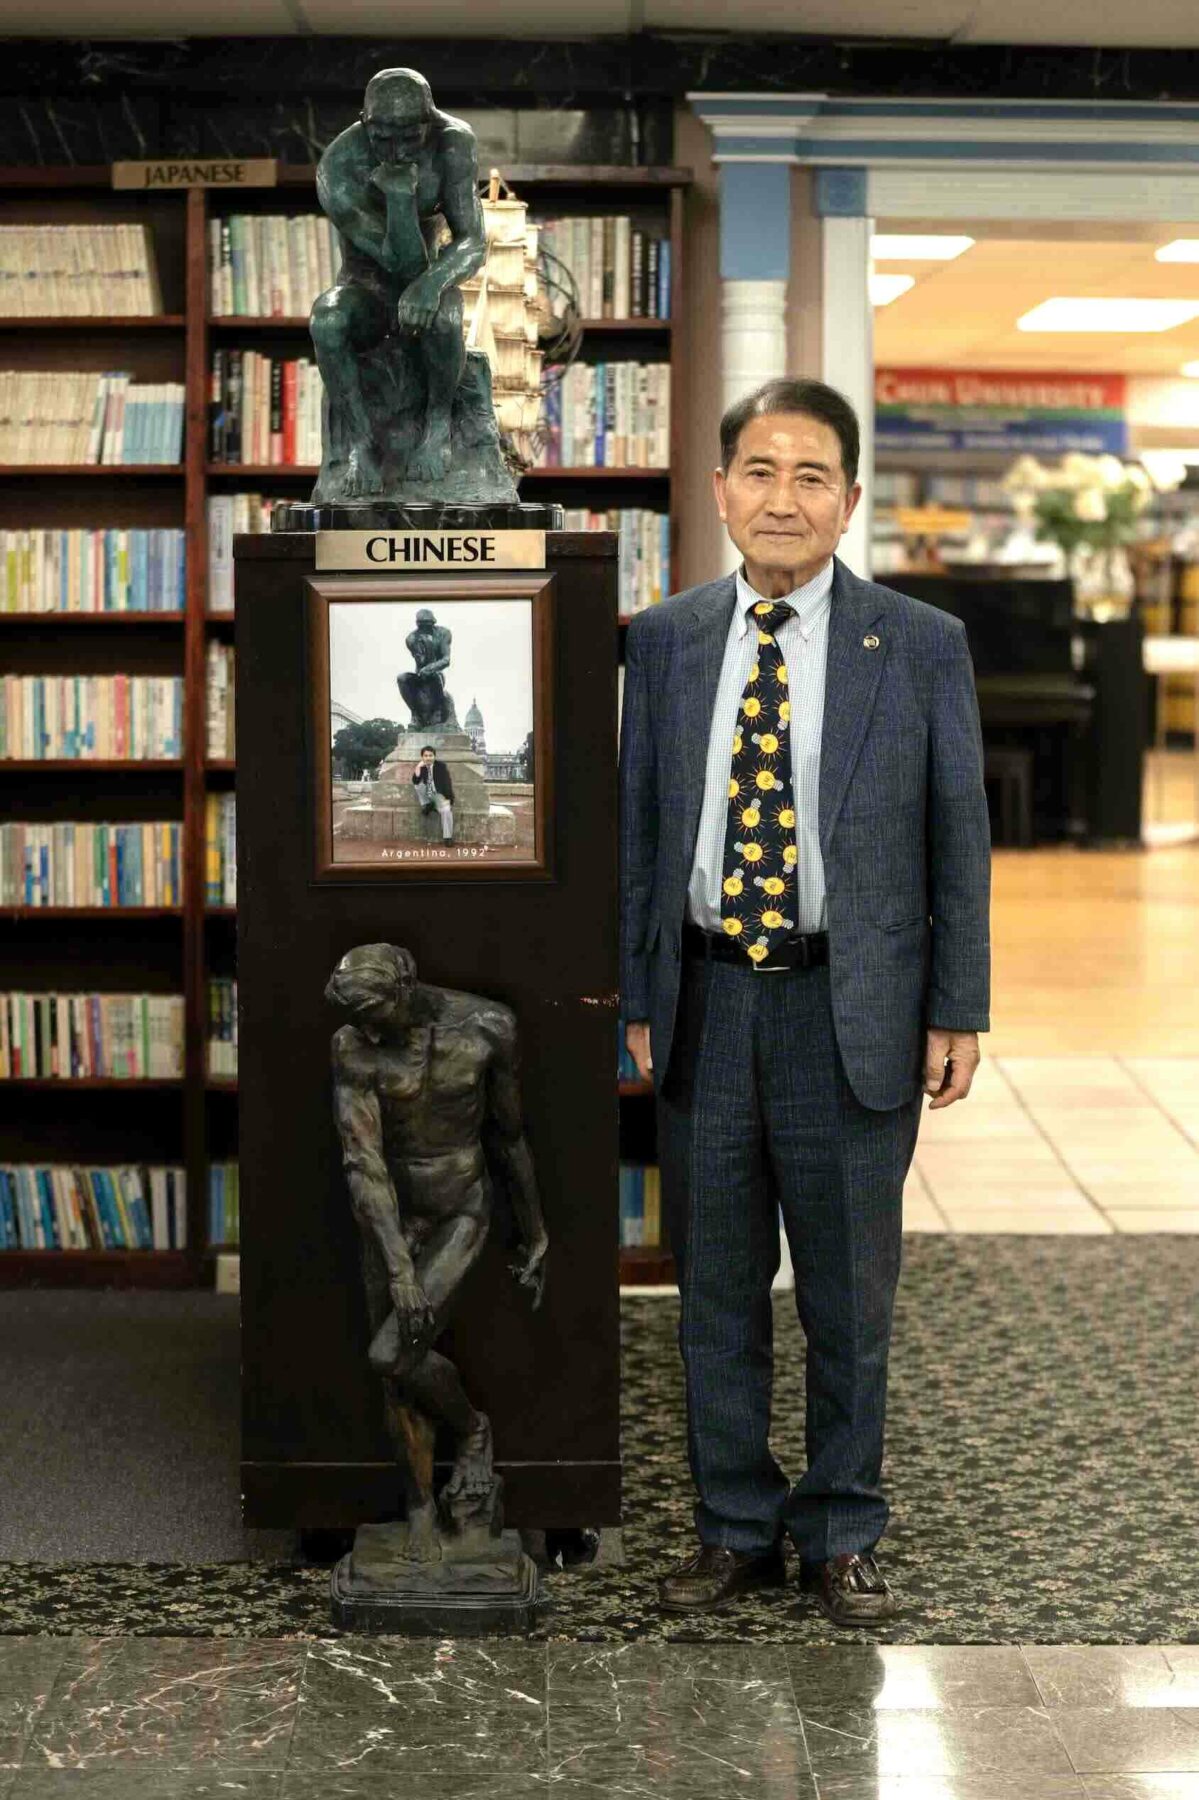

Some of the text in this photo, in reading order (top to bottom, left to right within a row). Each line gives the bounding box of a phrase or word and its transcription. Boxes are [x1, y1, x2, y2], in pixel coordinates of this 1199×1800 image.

[144, 164, 246, 187] JAPANESE
[365, 536, 496, 563] CHINESE
[381, 848, 485, 859] Argentina, 1992
